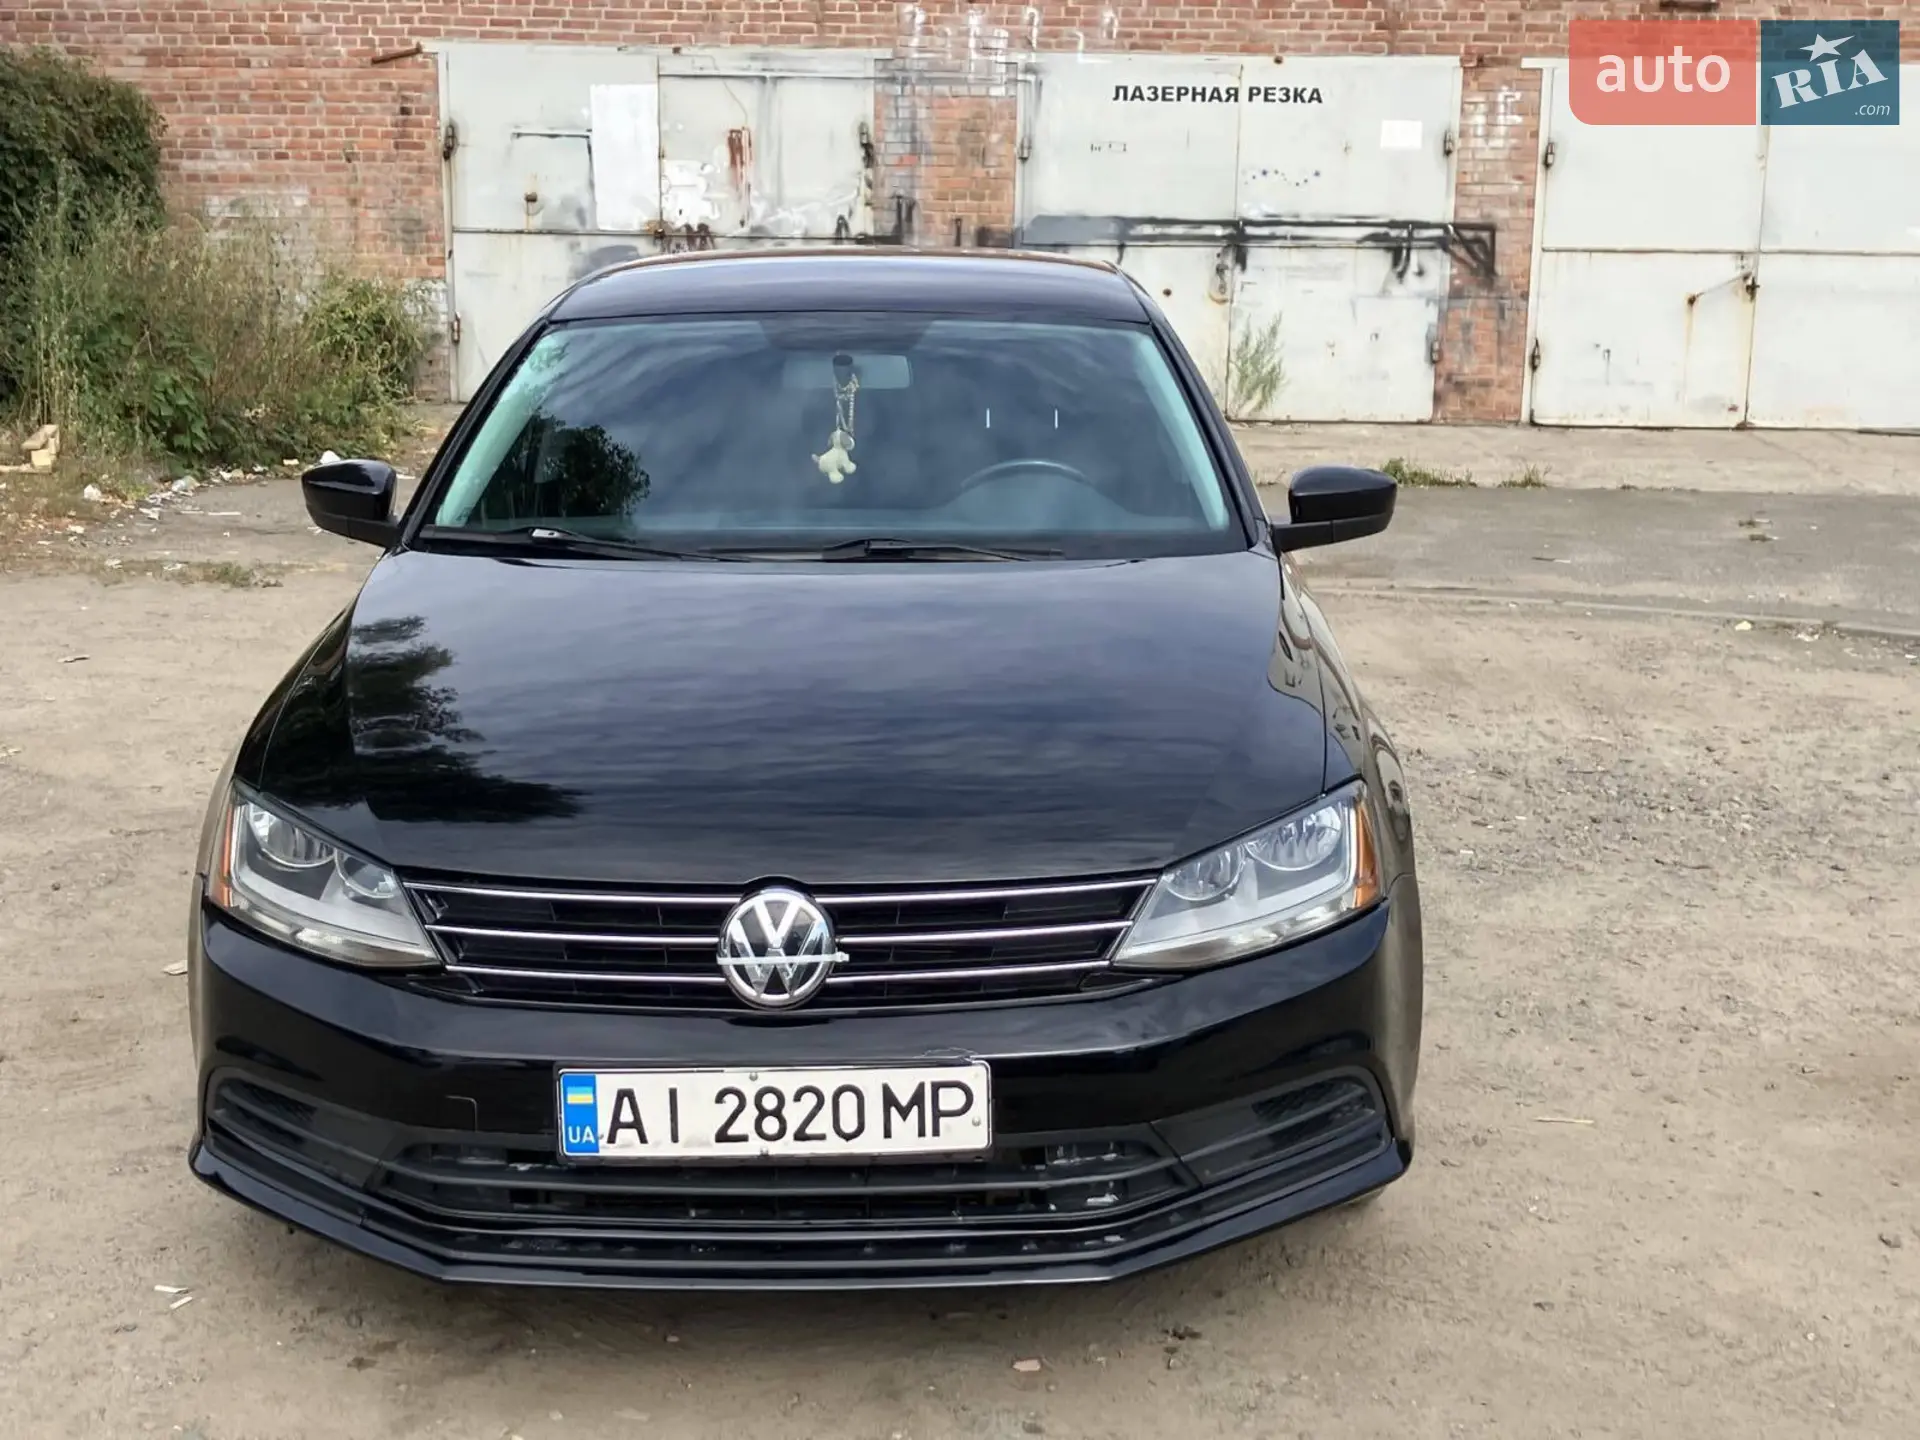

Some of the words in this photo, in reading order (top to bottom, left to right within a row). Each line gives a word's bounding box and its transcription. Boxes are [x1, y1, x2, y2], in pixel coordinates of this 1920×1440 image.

[1113, 85, 1240, 103] ЛАЗЕРНАЯ
[1248, 86, 1323, 104] РЕЗКА
[606, 1086, 681, 1144] AI
[714, 1083, 866, 1143] 2820
[882, 1081, 974, 1139] MP
[568, 1125, 596, 1143] UA
